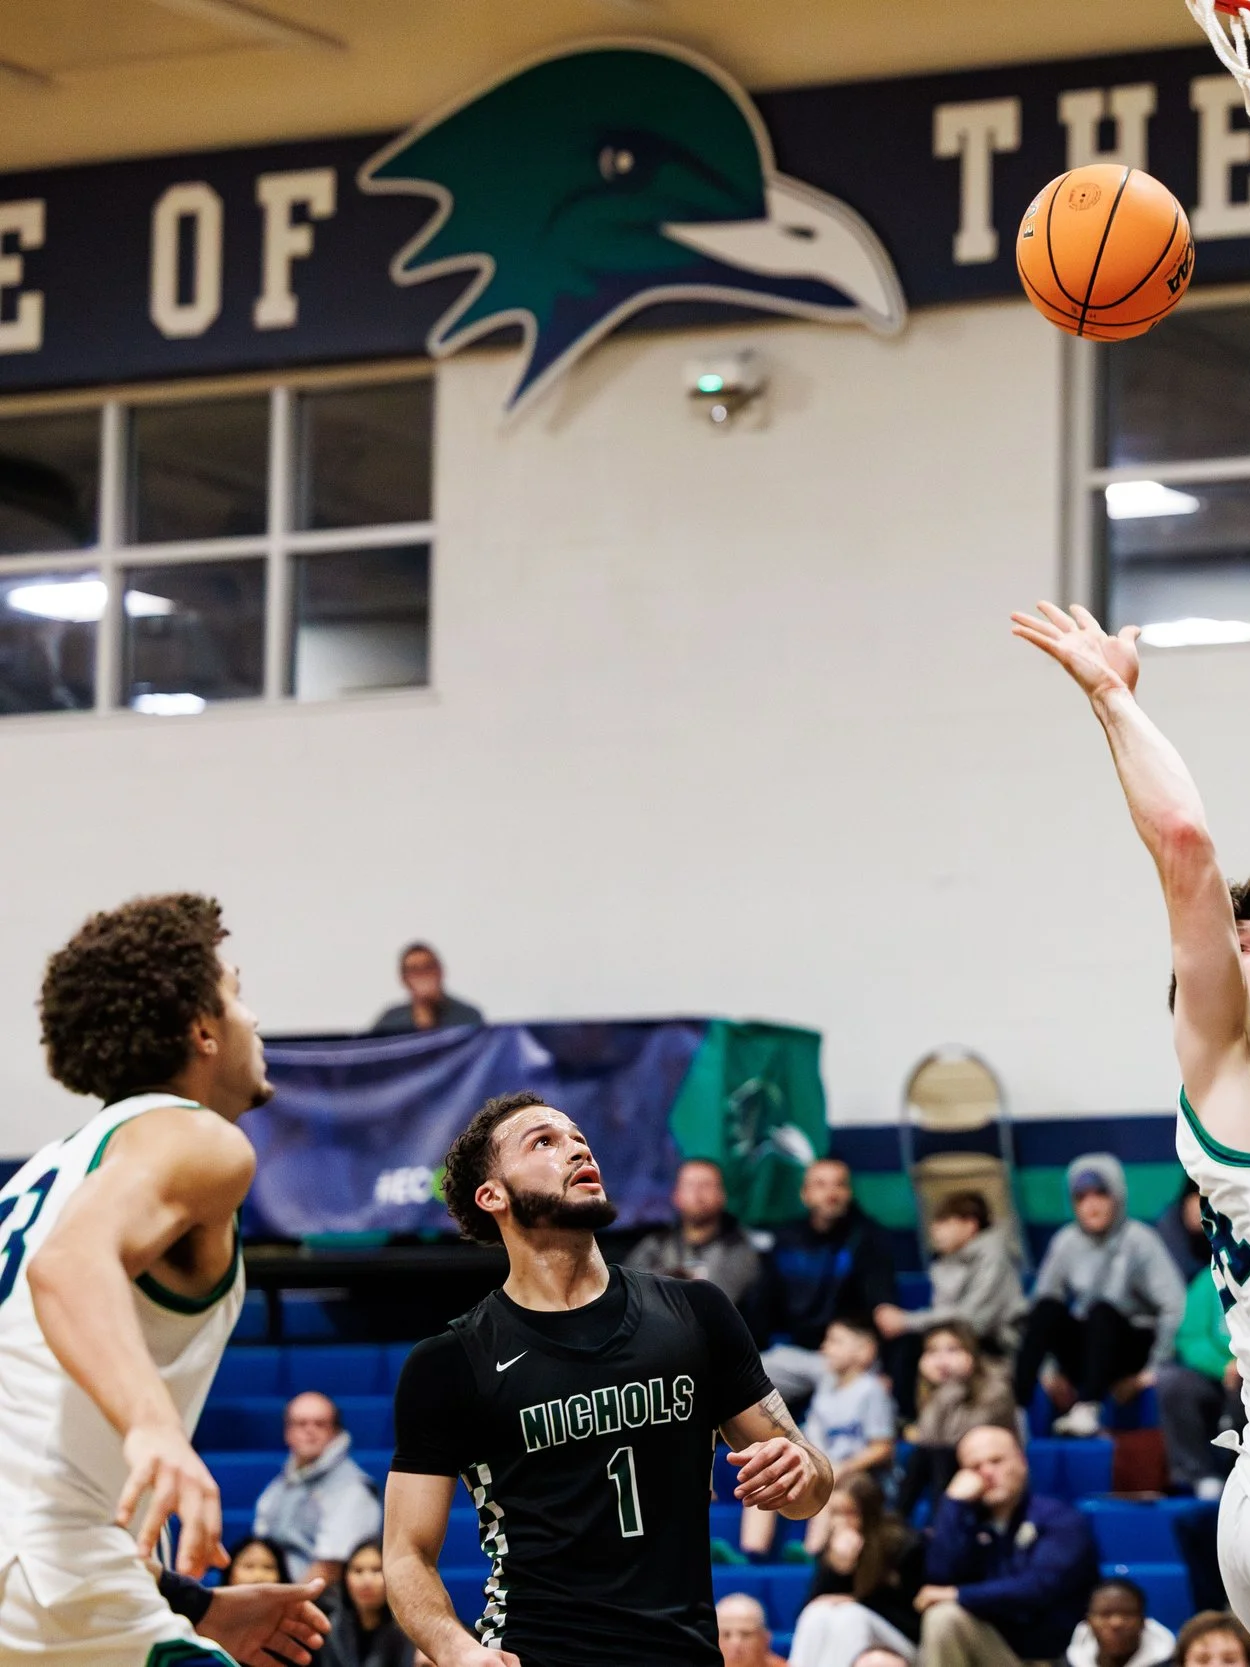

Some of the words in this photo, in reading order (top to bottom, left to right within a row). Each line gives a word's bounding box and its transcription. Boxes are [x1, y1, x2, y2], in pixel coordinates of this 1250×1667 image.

[149, 167, 338, 340] OF
[519, 1374, 695, 1453] NICHOLS
[606, 1446, 645, 1539] 1
